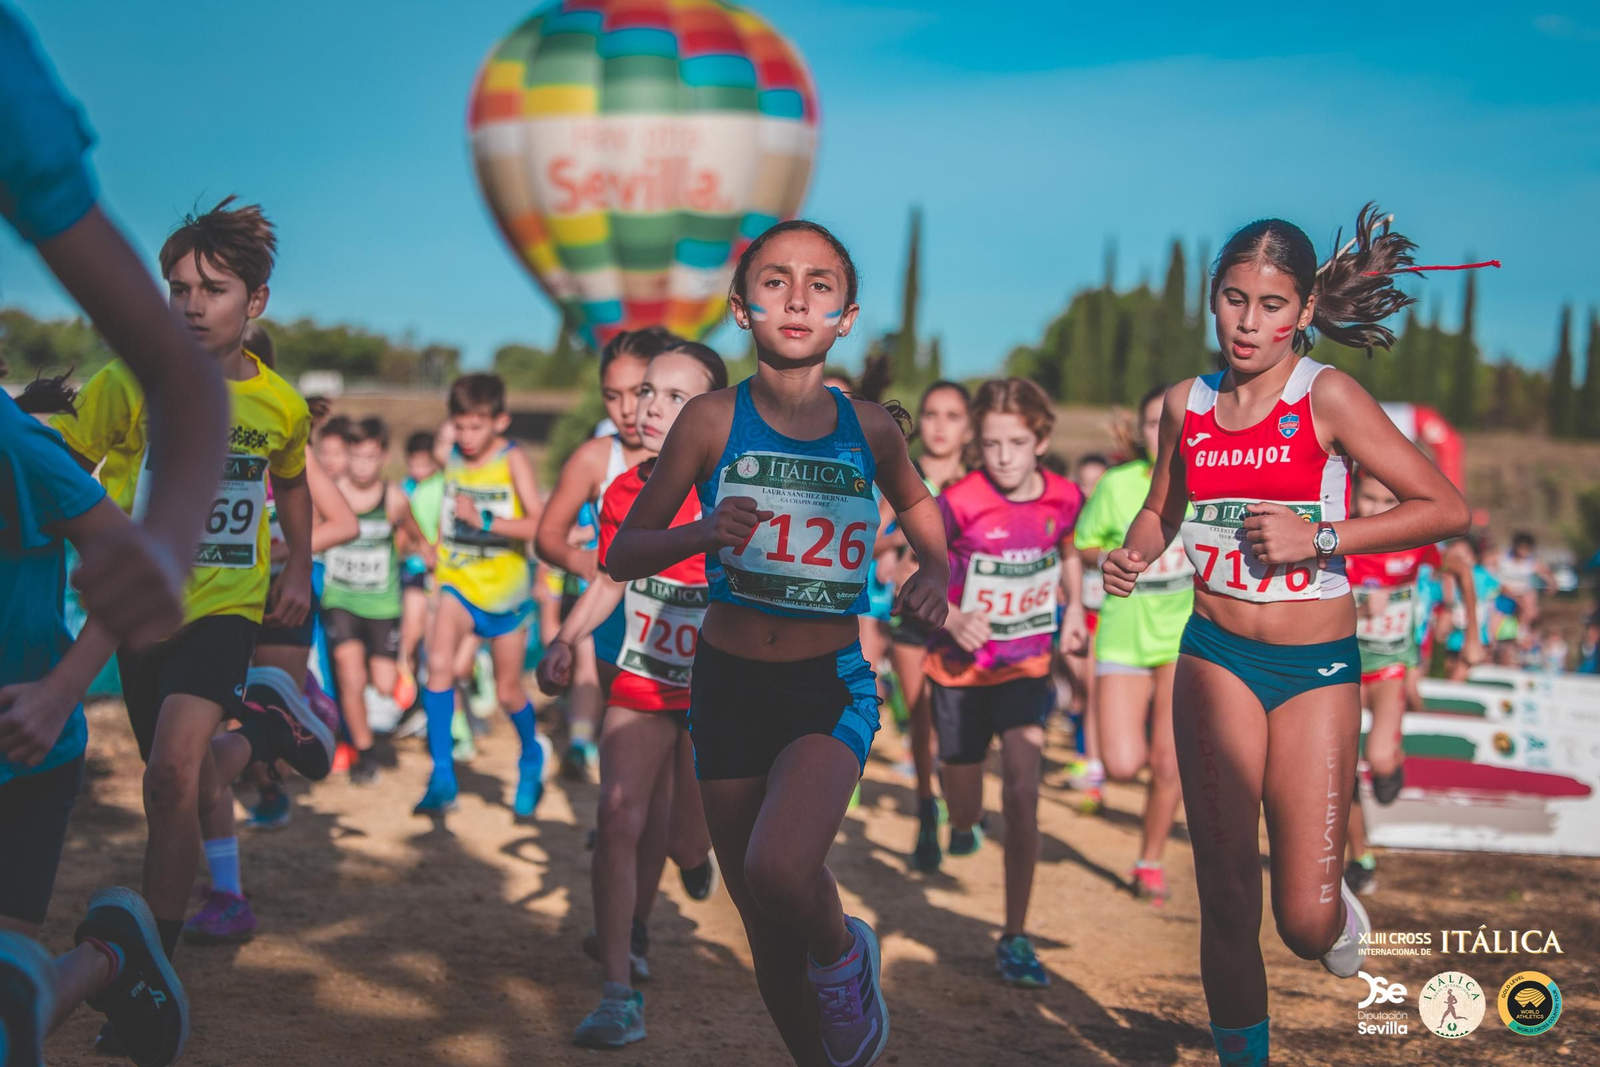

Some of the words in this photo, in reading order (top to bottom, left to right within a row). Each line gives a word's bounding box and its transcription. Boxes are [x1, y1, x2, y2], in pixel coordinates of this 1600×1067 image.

[1195, 445, 1291, 469] GUADAJOZ
[769, 460, 846, 485] ITÁLICA
[762, 487, 786, 497] LAURA
[821, 494, 849, 503] BERNAL
[811, 500, 831, 508] JEREZ
[204, 497, 254, 536] 69
[977, 580, 1053, 616] 5166
[634, 610, 698, 658] 720
